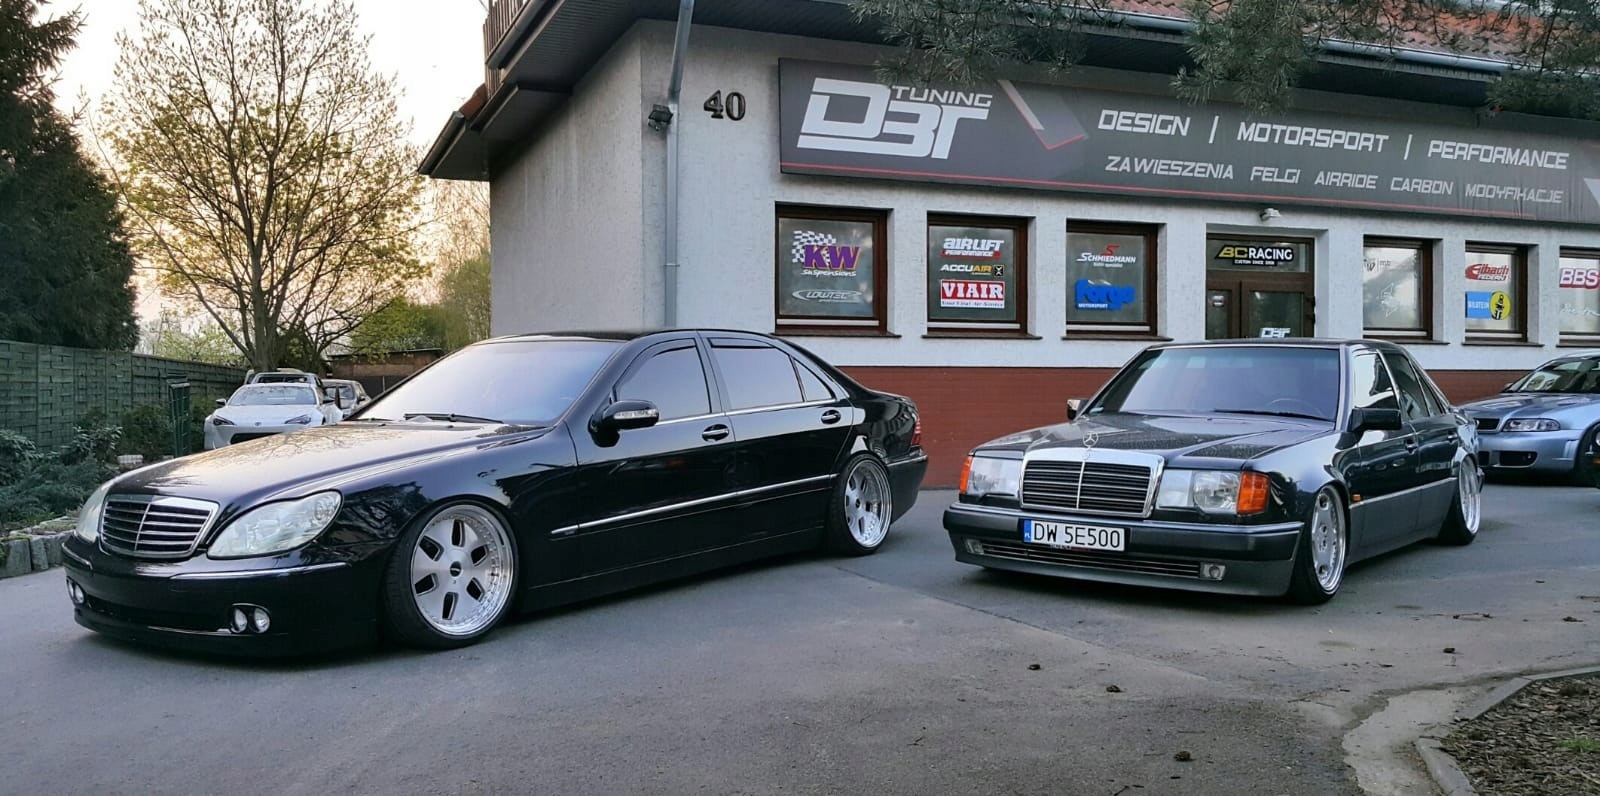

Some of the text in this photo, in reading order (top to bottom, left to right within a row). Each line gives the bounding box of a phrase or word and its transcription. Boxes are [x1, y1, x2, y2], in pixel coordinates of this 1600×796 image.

[703, 89, 746, 121] 40
[891, 85, 993, 107] TUNING
[1098, 109, 1570, 170] DESIGN MOTORSPORT PERFORMANCE
[1105, 155, 1234, 180] ZAWIESZENIA
[1250, 166, 1301, 184] FELGI
[1314, 170, 1379, 189] AIRRIDE
[1390, 176, 1454, 195] CARBON
[803, 244, 862, 270] KW
[1249, 248, 1293, 260] RACING
[940, 263, 993, 272] ACCUAIR
[1560, 268, 1599, 288] BBS
[942, 282, 1004, 299] VIAIR
[1034, 523, 1121, 548] DW 5E500
